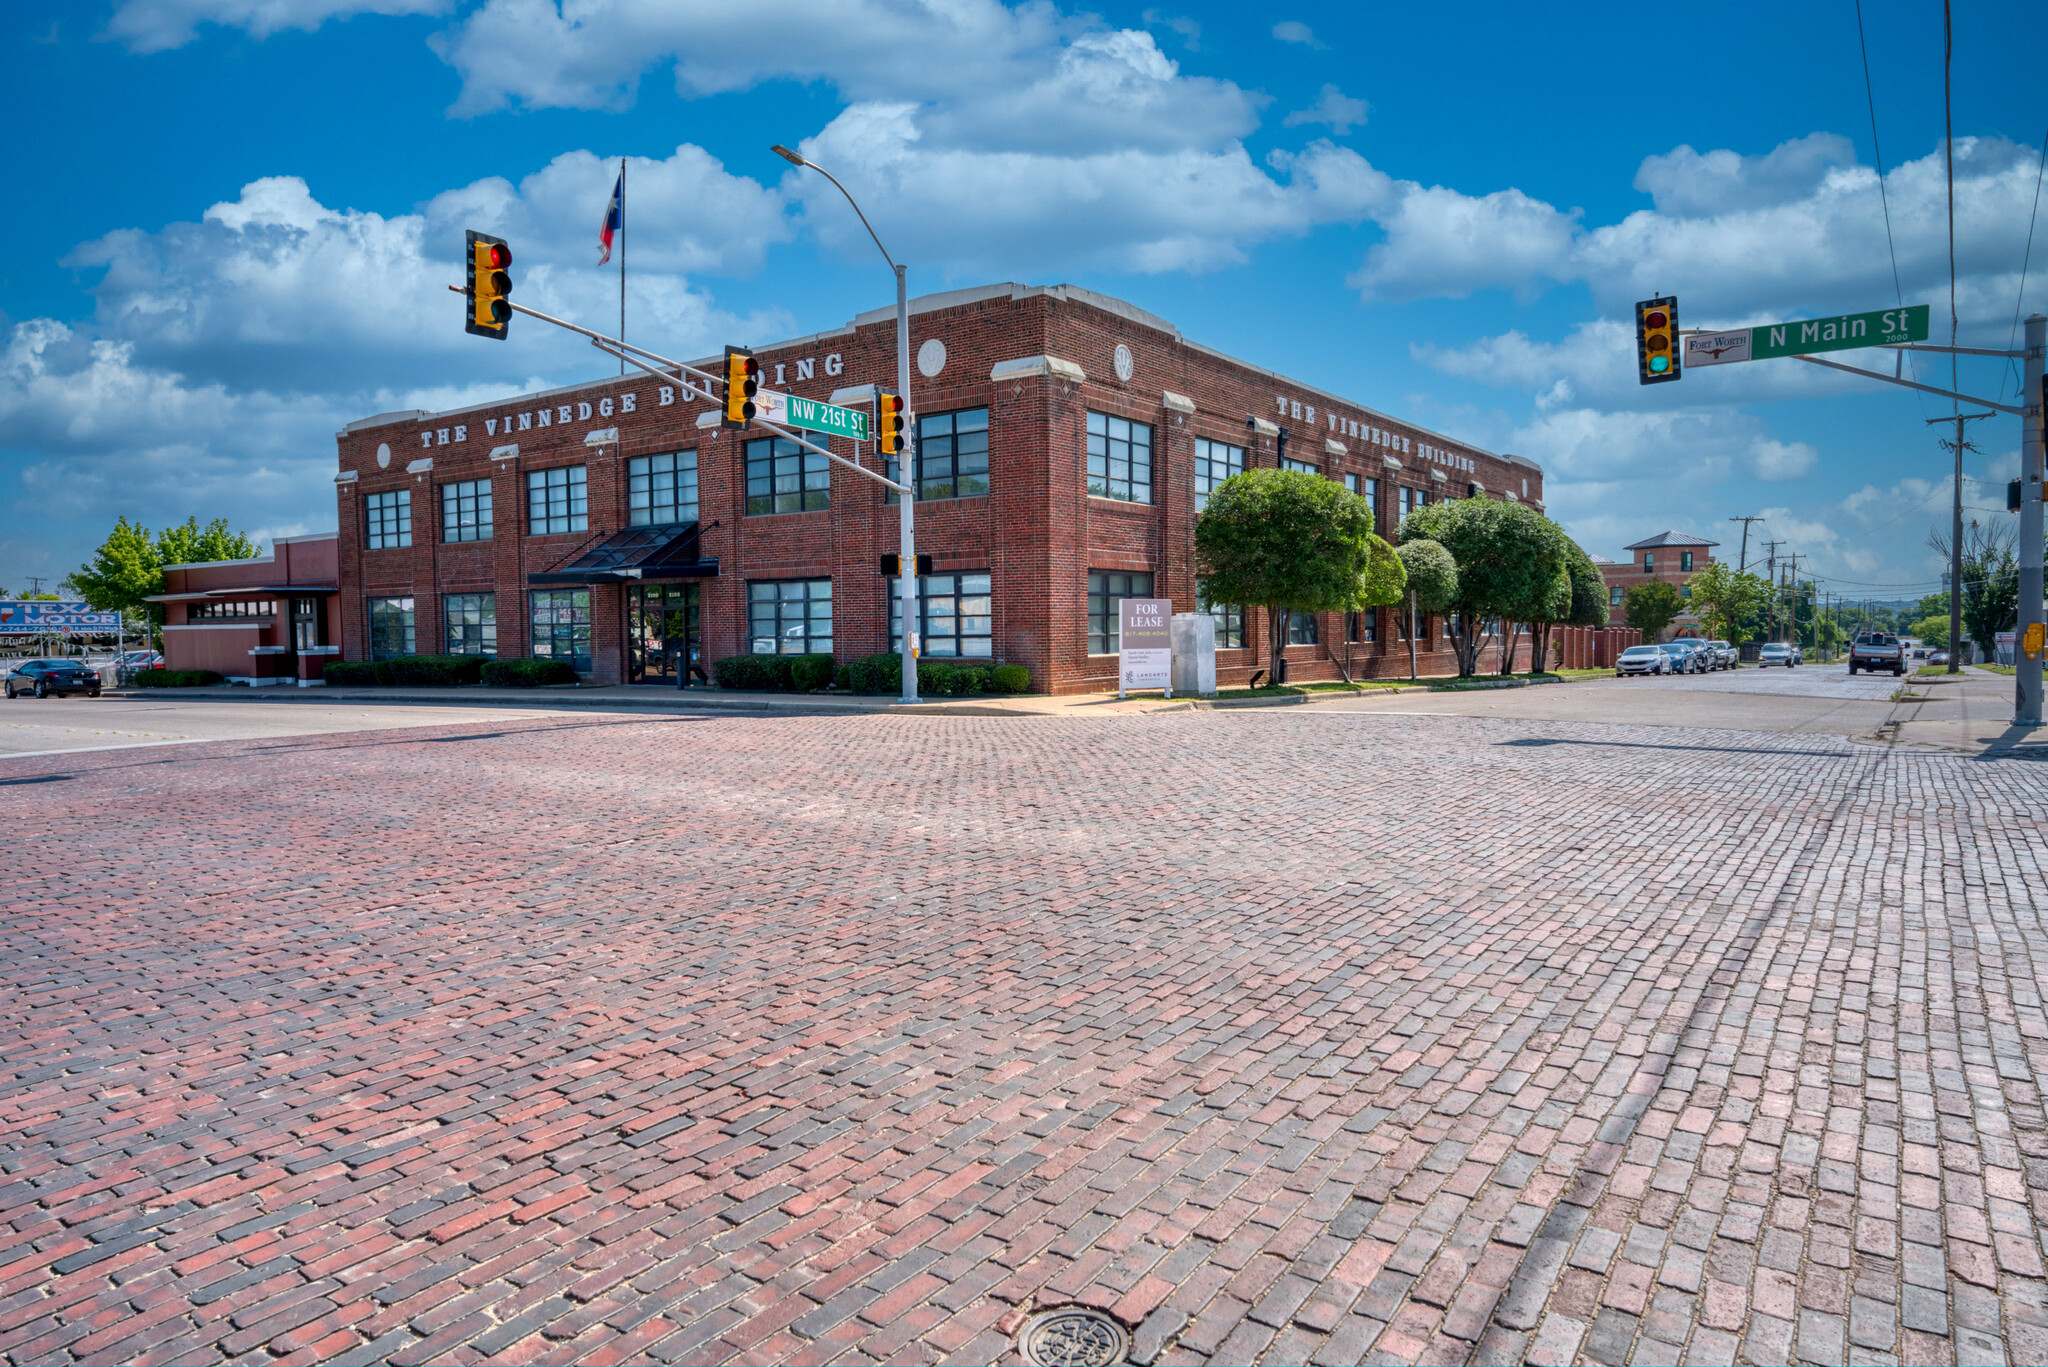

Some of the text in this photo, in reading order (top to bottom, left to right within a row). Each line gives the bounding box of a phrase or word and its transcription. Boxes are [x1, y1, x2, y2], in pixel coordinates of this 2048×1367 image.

[1769, 310, 1909, 348] N Main St
[1689, 335, 1747, 351] FORT WORTH
[1885, 333, 1909, 343] 2000
[421, 353, 845, 448] THE VINNEDGE BUIDING
[792, 398, 864, 431] NW 21st St
[1276, 396, 1475, 474] THE VINNEDGE BUILDING
[1136, 604, 1158, 615] FOR
[24, 614, 117, 624] MOTOR
[1130, 616, 1164, 627] LEASE
